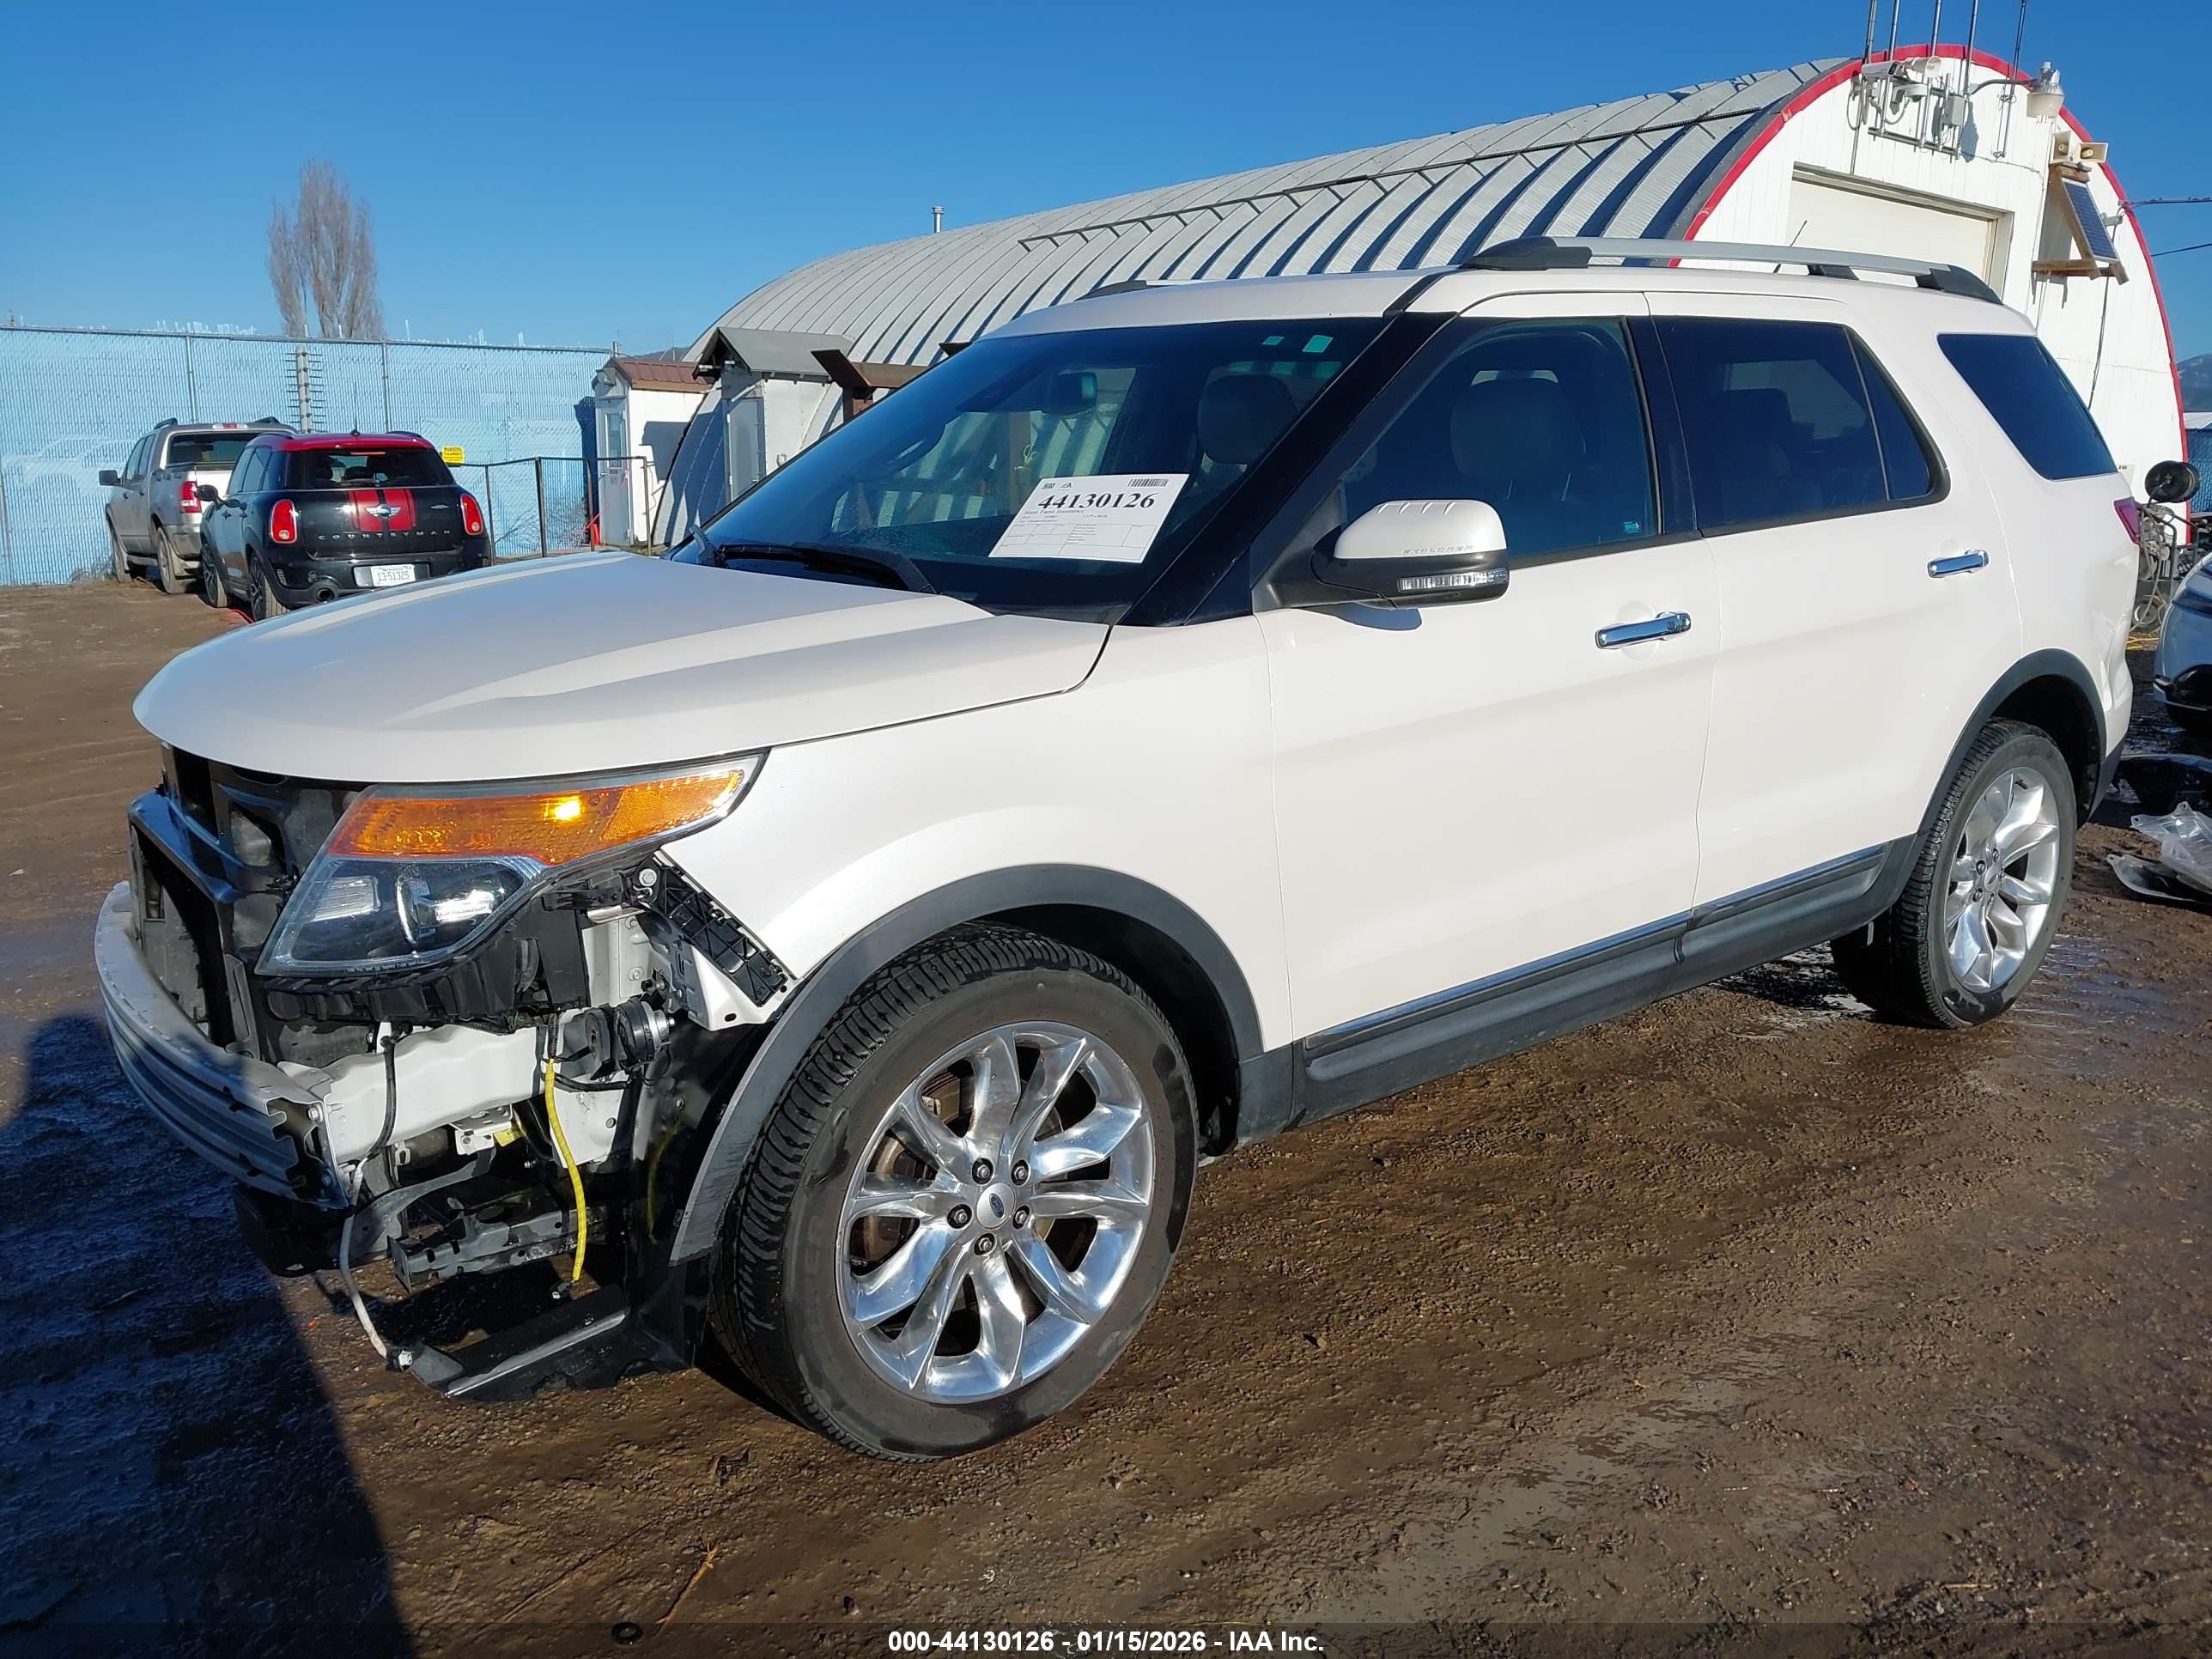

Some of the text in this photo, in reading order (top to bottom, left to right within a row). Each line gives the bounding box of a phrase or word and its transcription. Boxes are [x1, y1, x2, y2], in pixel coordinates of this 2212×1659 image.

[1037, 492, 1160, 509] 44130126
[317, 529, 451, 541] COUNTRYMAN
[1401, 544, 1474, 555] EXPLORER
